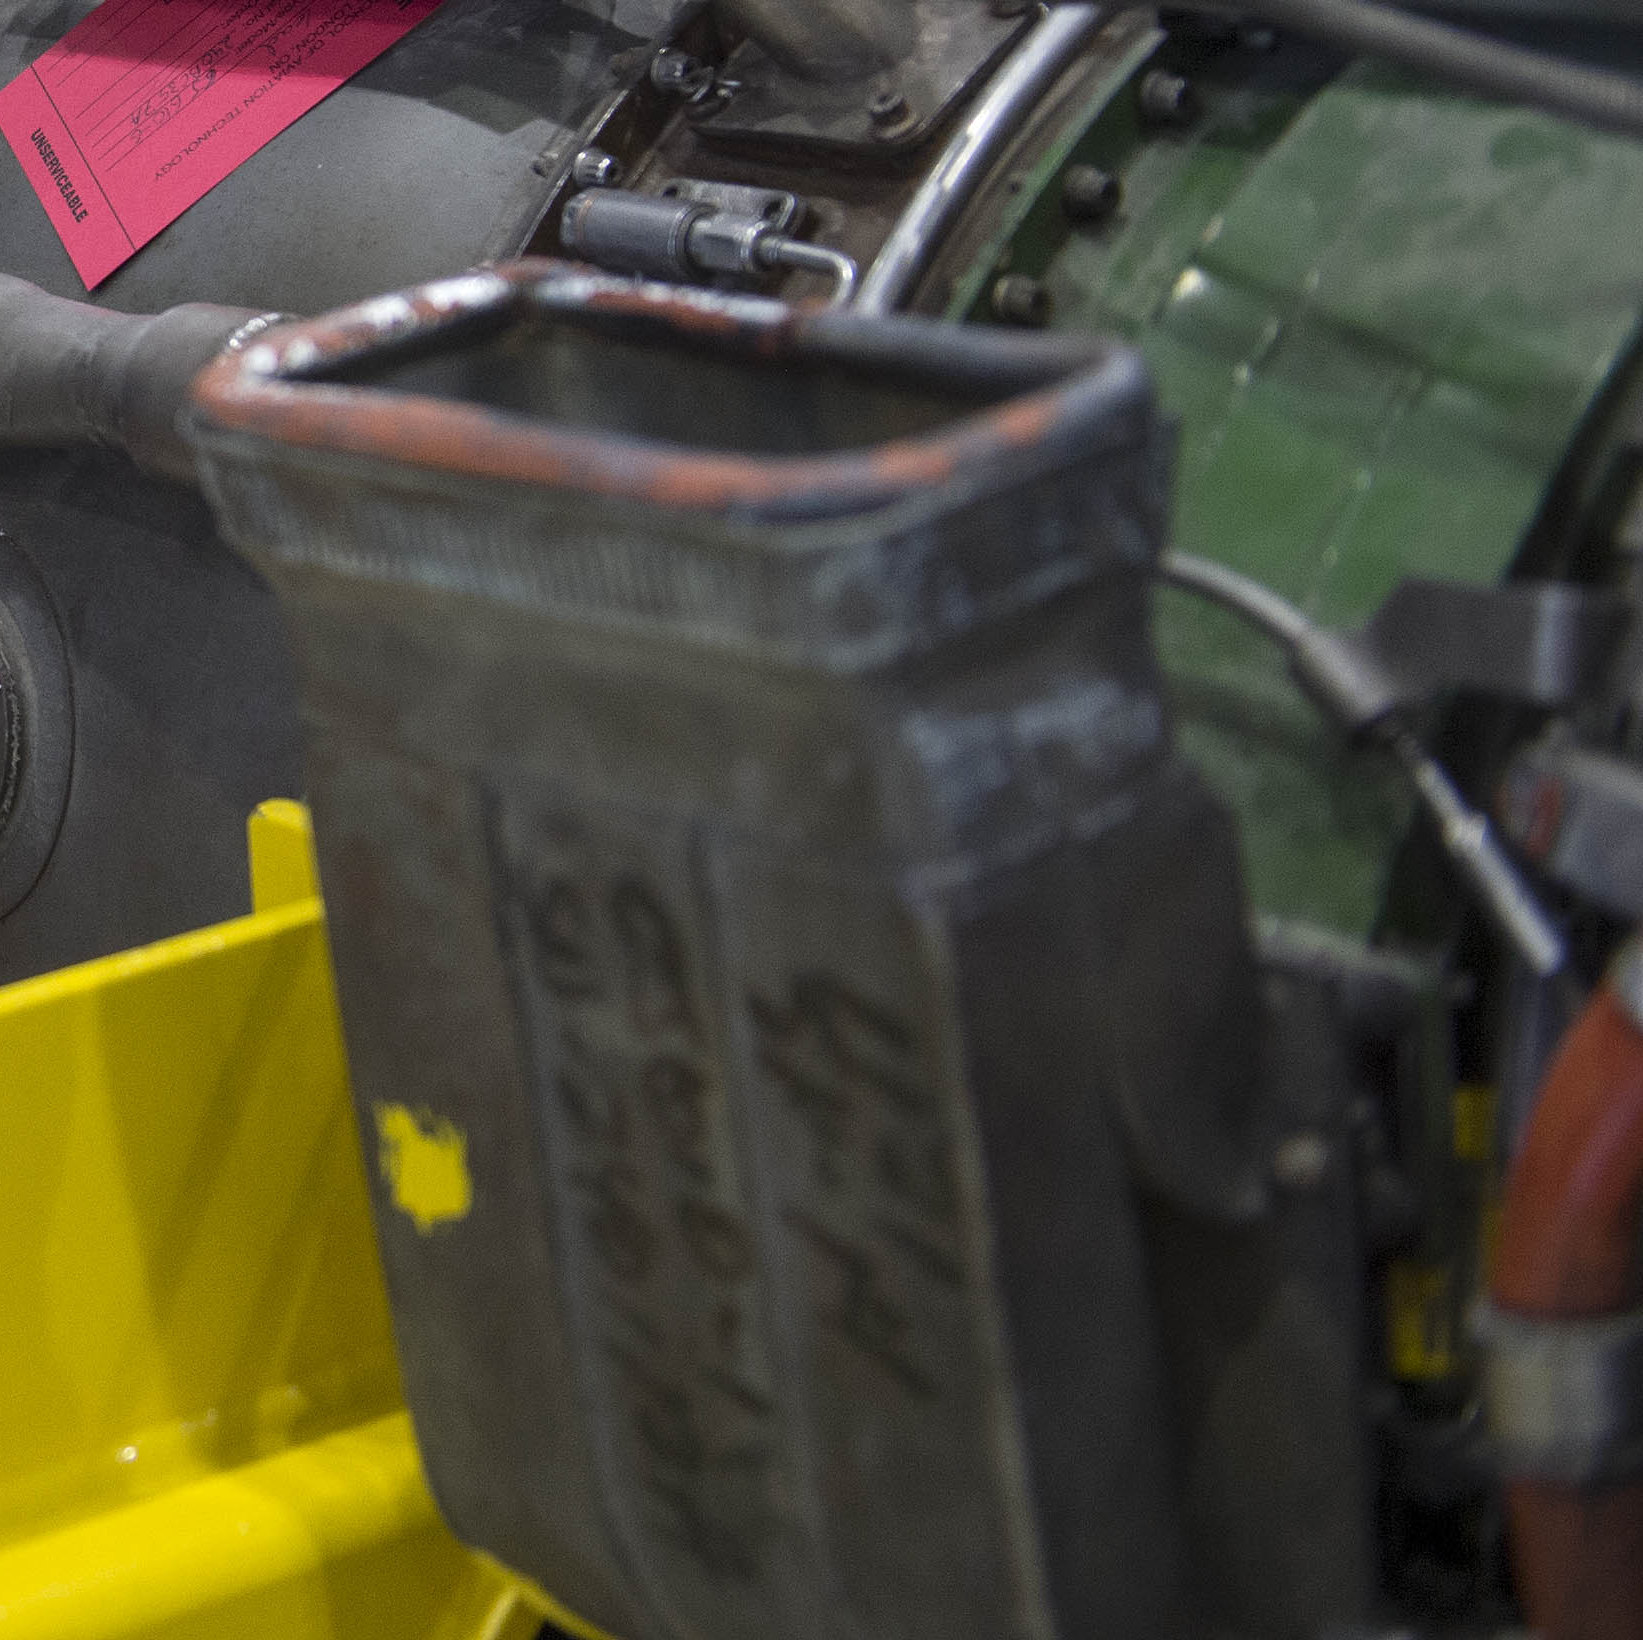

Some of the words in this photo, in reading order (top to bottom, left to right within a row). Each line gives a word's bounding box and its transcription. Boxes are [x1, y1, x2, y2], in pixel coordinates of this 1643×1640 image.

[266, 51, 293, 75] ON
[301, 37, 326, 59] OF
[241, 54, 305, 108] AVIATION
[150, 105, 242, 182] TECHNOLOGY
[31, 127, 88, 223] UNSERVICEABLE
